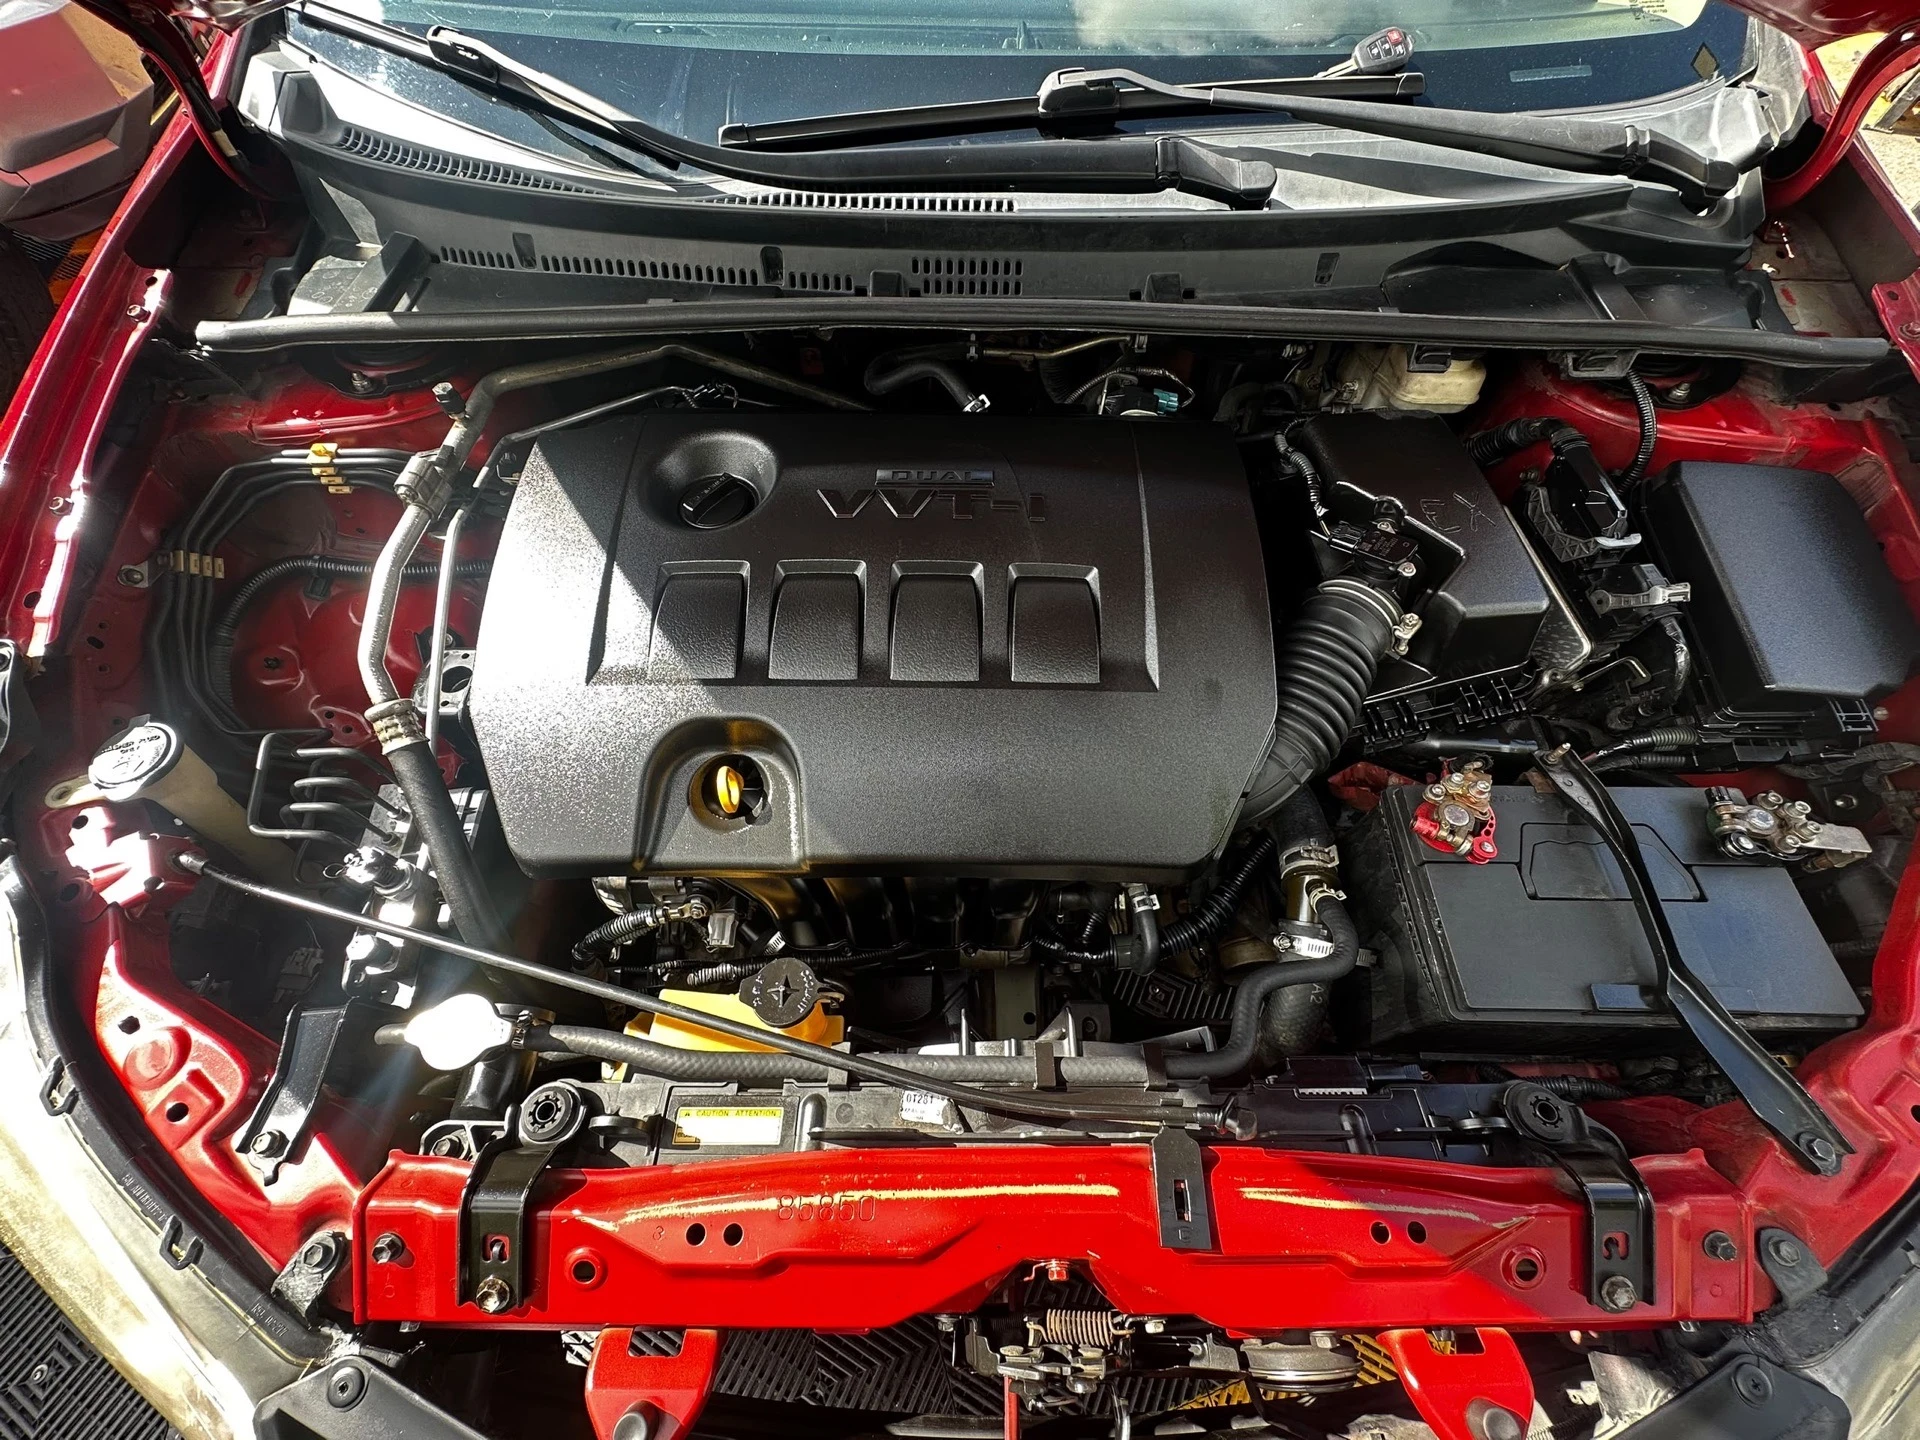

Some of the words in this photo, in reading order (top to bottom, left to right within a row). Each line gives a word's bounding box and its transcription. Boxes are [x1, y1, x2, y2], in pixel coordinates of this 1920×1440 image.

[891, 470, 983, 481] DUAL
[1310, 983, 1325, 1004] A2
[696, 1109, 729, 1117] CAUTION
[735, 1109, 777, 1117] ATTENTION
[777, 1194, 876, 1222] 85850
